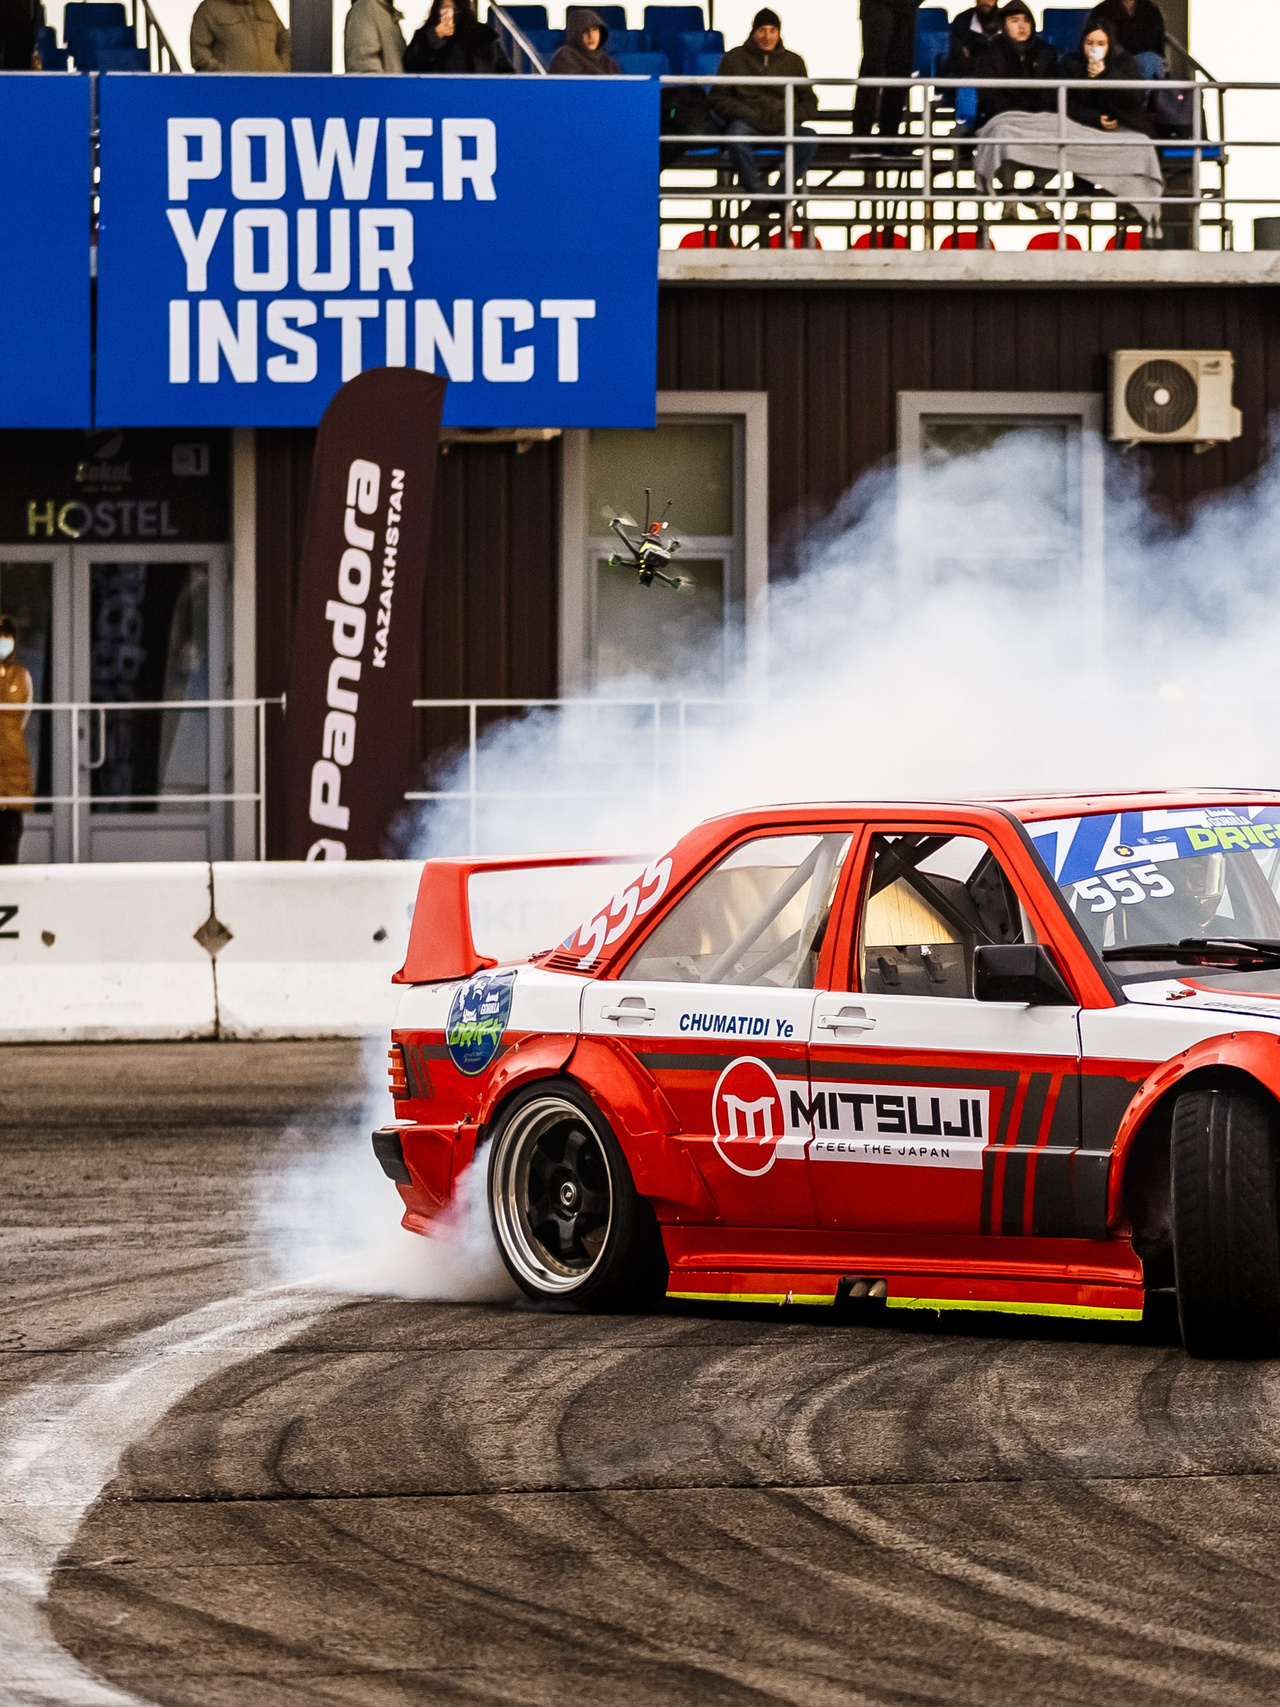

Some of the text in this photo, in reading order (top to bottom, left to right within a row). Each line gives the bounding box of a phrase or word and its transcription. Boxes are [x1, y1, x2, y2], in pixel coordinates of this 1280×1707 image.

[166, 116, 498, 202] POWER
[165, 207, 415, 292] YOUR
[168, 298, 597, 384] INSTINCT
[27, 501, 180, 539] HOSTEL
[372, 468, 406, 669] KAZAKHSTAN
[308, 458, 381, 832] Pandora
[1206, 815, 1253, 828] GORILLA
[575, 856, 674, 970] 555
[1072, 863, 1176, 914] 555
[679, 1013, 794, 1039] CHUMATIDI Ye
[789, 1089, 984, 1139] MITSUJI
[816, 1142, 951, 1159] FEEL THE JAPAN
